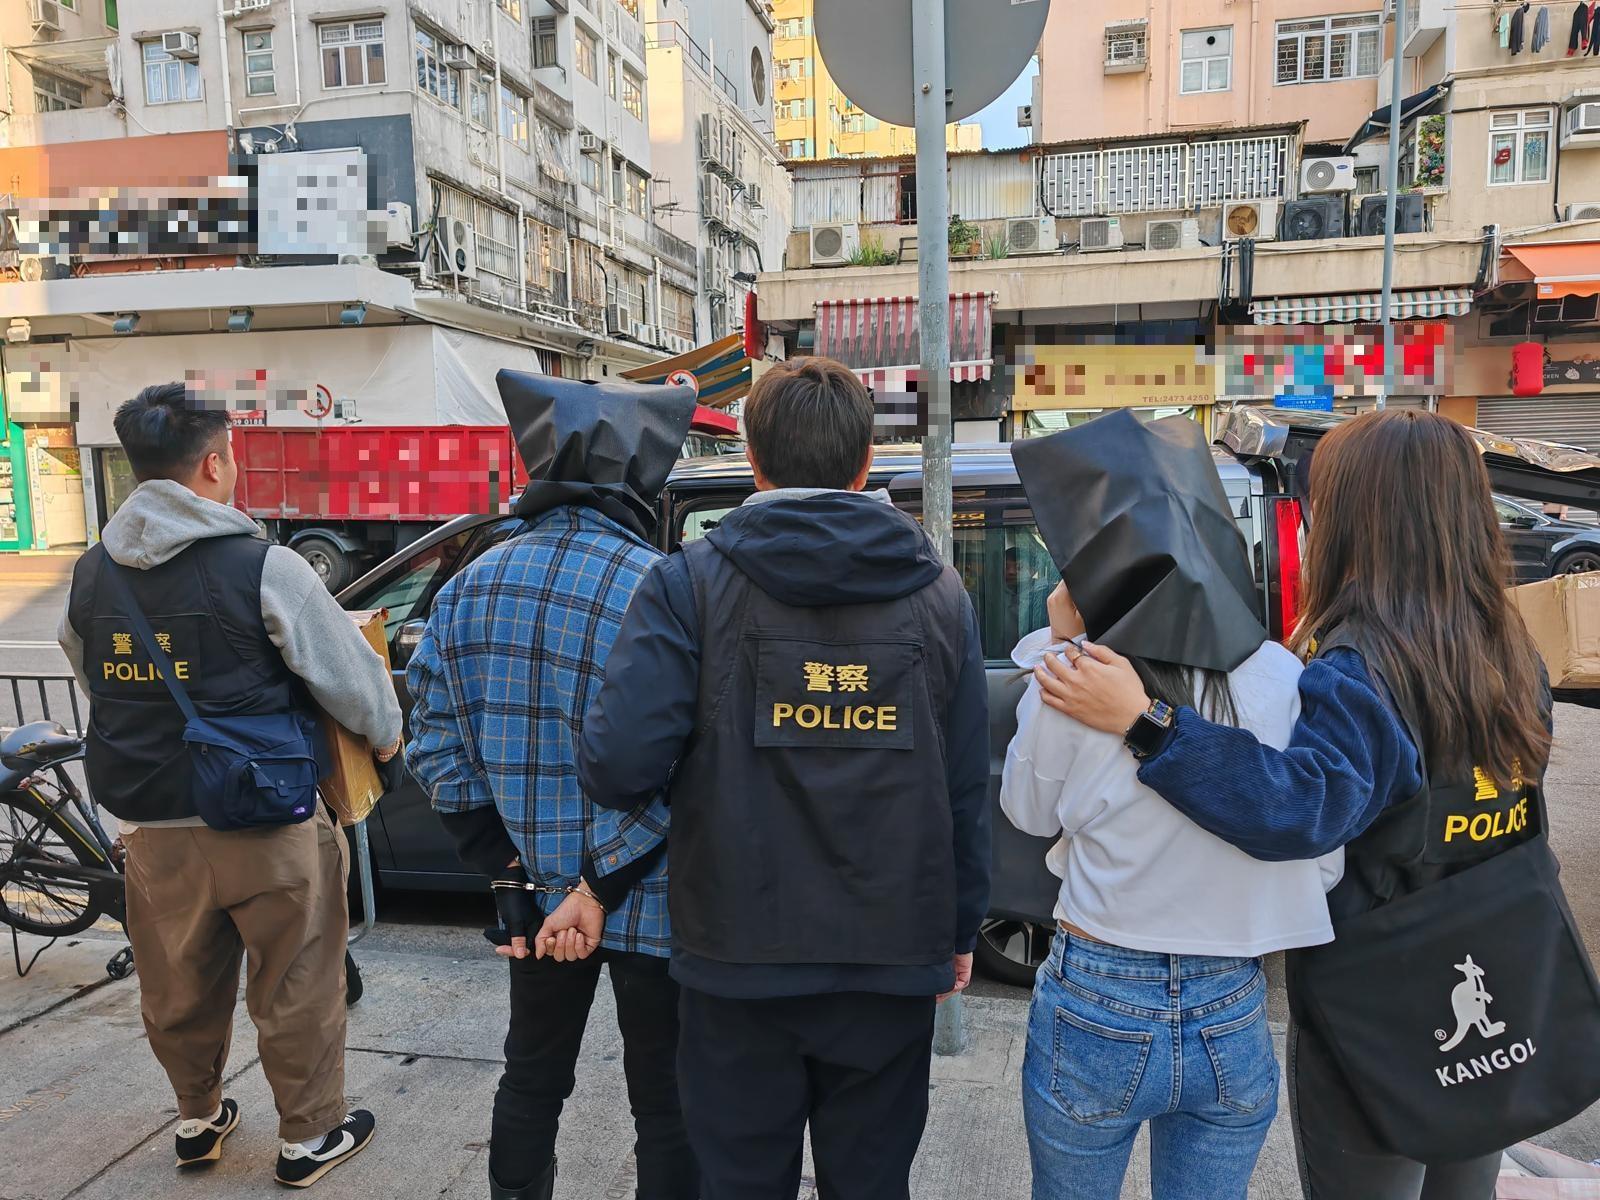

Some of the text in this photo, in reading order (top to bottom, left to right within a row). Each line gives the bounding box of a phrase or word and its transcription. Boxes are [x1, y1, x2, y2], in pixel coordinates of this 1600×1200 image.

[803, 661, 869, 692] 警察
[773, 702, 897, 731] POLICE
[1435, 1037, 1537, 1087] KANGOL
[182, 1125, 199, 1135] NIKE
